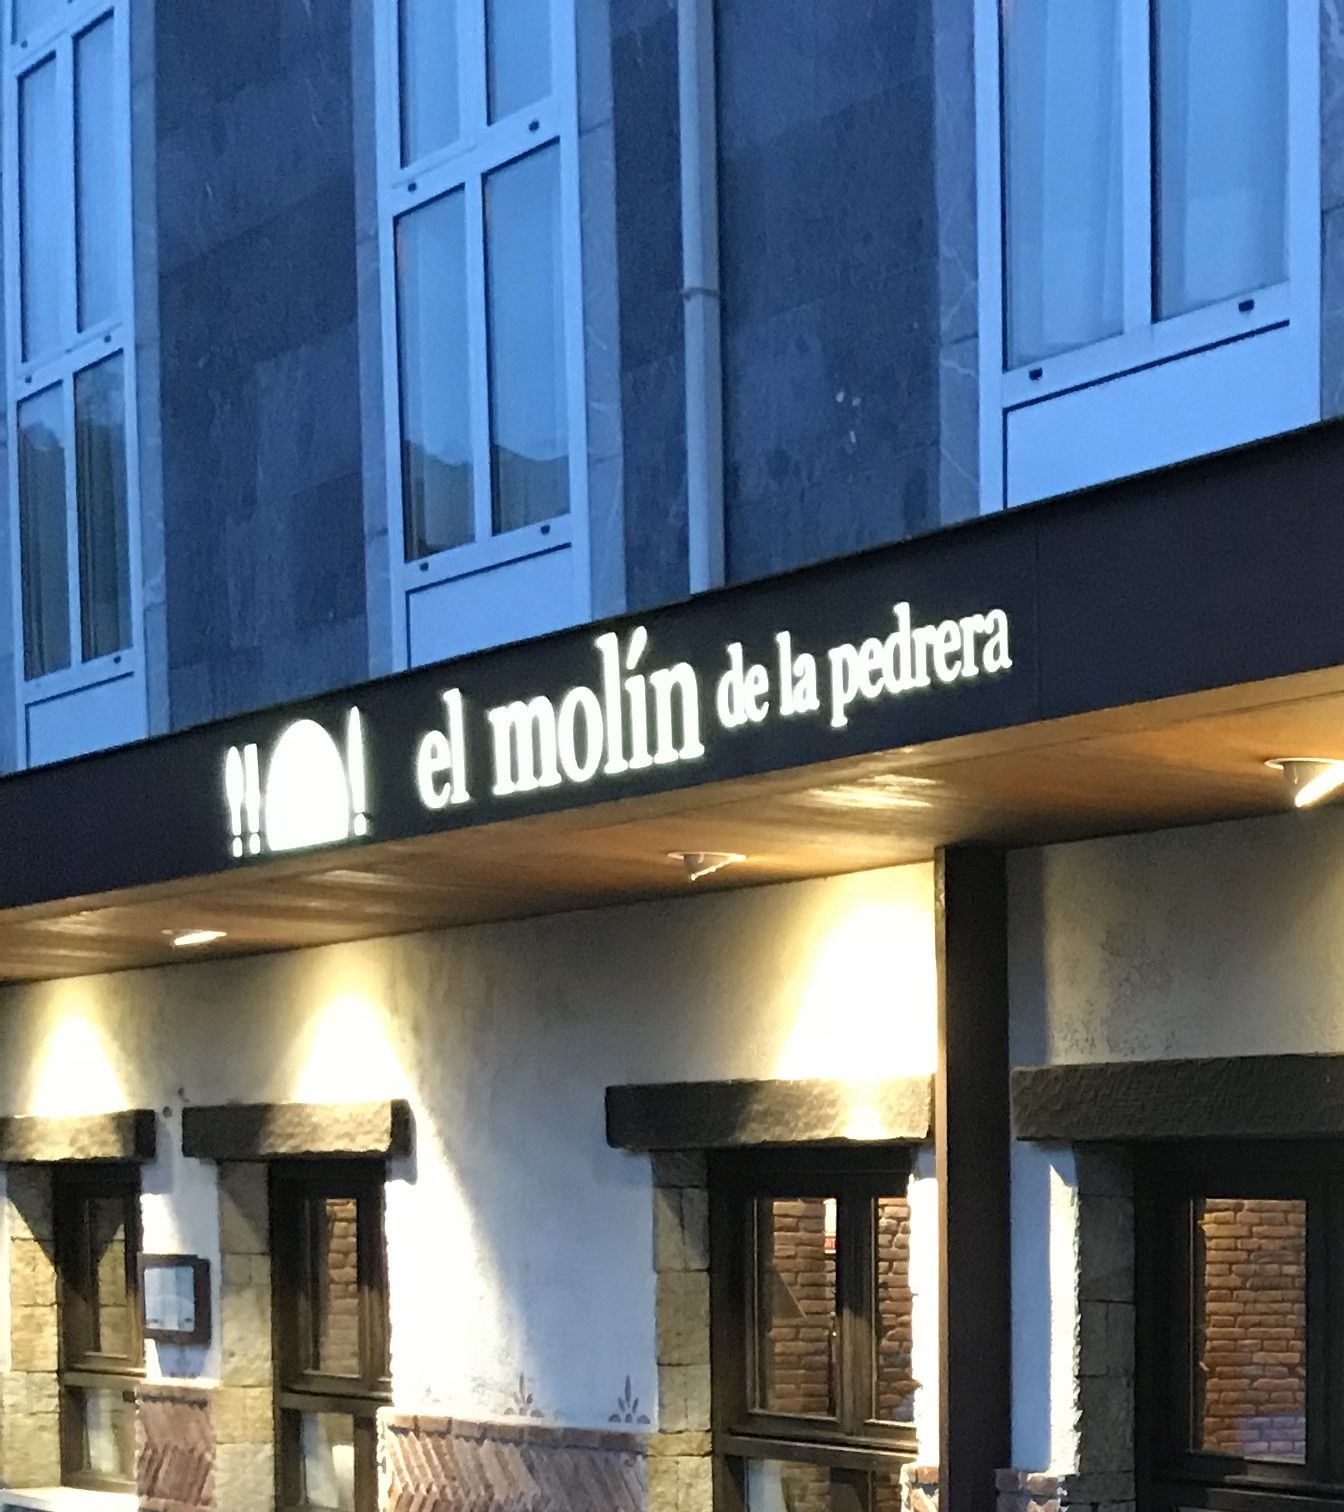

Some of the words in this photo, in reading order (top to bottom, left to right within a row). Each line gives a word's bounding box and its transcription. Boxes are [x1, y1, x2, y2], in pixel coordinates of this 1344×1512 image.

[416, 688, 469, 811] el
[488, 626, 706, 796] molín
[716, 643, 770, 729] de
[776, 631, 819, 715] la
[828, 601, 1013, 729] pedrera
